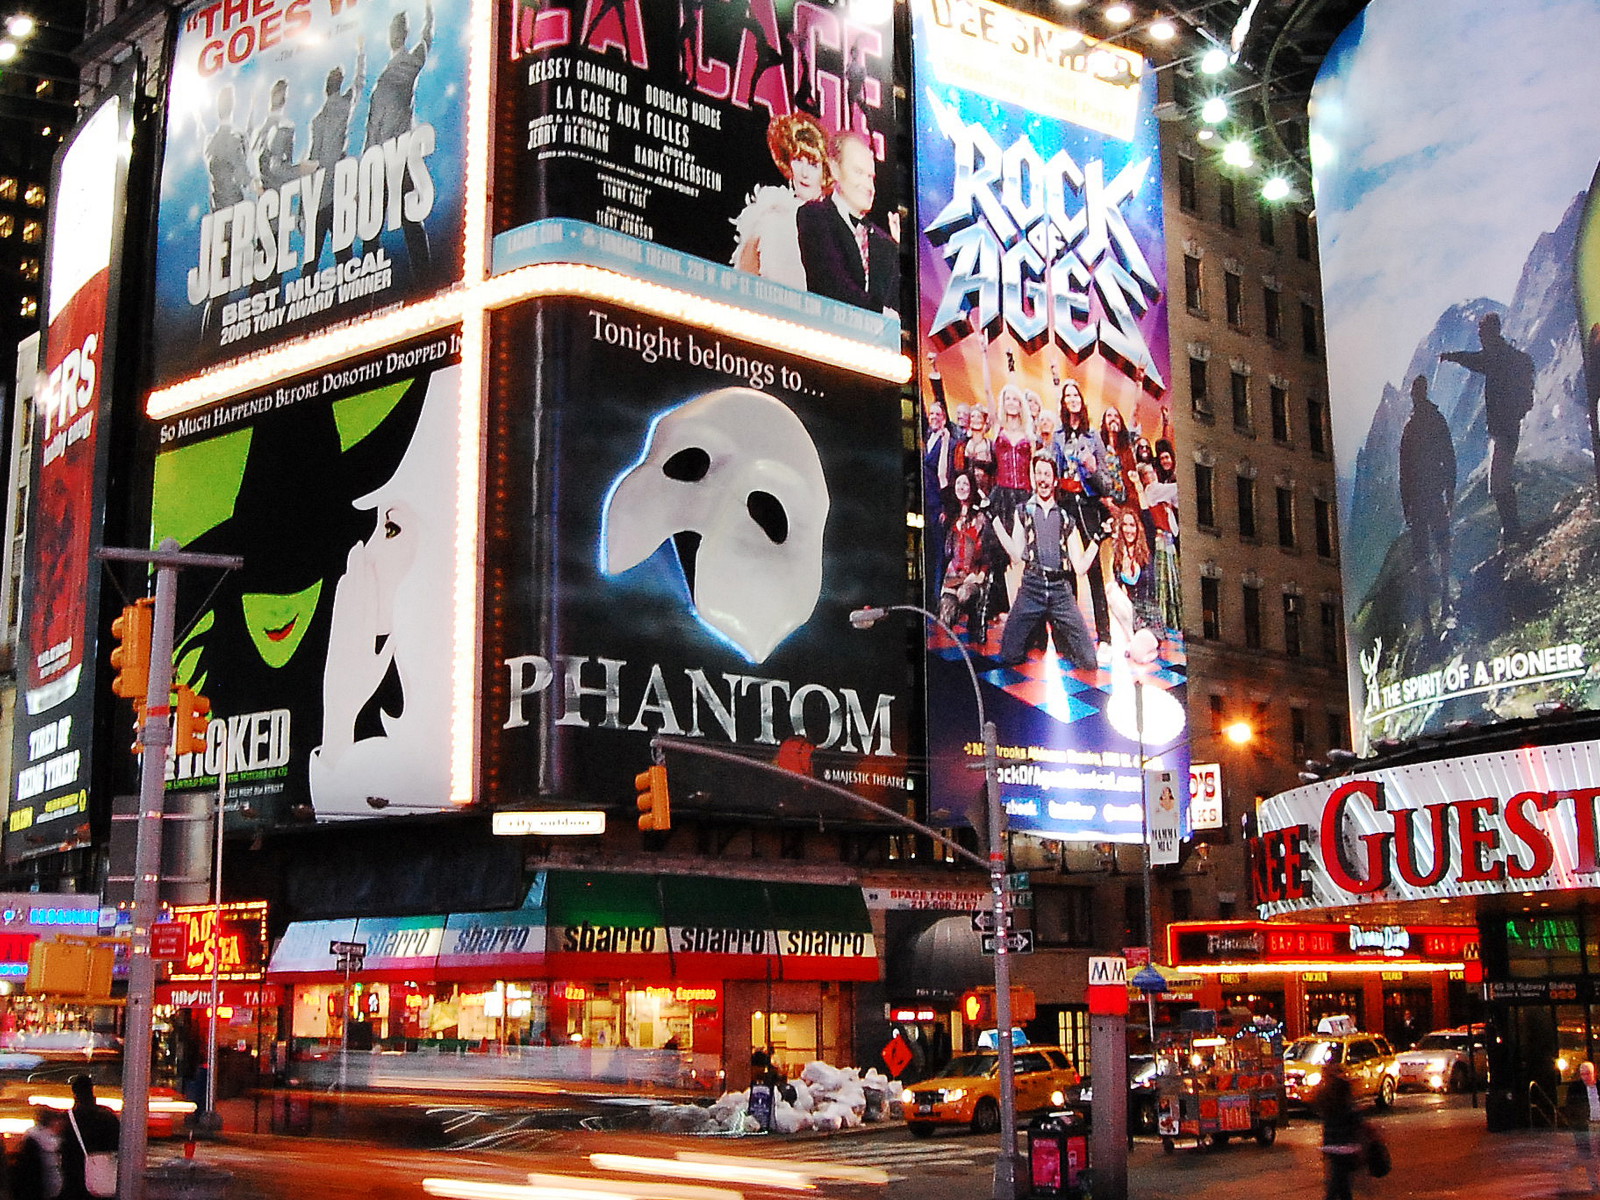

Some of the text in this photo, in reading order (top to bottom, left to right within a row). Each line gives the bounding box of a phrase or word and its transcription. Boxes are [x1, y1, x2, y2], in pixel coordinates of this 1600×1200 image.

[198, 0, 312, 78] GOES
[528, 58, 628, 95] KELSEY GRAMMER
[556, 85, 690, 148] LA CAGE AUX FOLLES
[646, 84, 722, 131] DOUGLAS HODGE
[563, 125, 609, 153] HERMAN
[634, 144, 672, 174] HARVEY
[187, 123, 436, 306] JERSEY BOYS
[923, 86, 1160, 304] ROCK
[222, 249, 391, 327] BEST MUSICAL
[254, 305, 287, 333] TONY
[286, 289, 336, 323] AWARD
[338, 268, 392, 304] WINNER
[927, 217, 1166, 392] AGES
[588, 309, 682, 364] Tonight
[688, 334, 775, 390] belongs
[160, 426, 177, 443] SO
[178, 414, 211, 442] MUCH
[213, 399, 273, 432] HAPPENED
[275, 382, 319, 409] BEFORE
[322, 361, 384, 397] DOROTHY
[386, 341, 447, 374] DROPPED
[1382, 643, 1584, 709] THE SPIRIT OF A PIONEER
[503, 654, 897, 757] PHANTOM
[832, 769, 870, 785] MAJESTIC
[872, 772, 905, 789] THEATRE
[890, 889, 985, 902] SPACE FOR RENT
[367, 929, 430, 956] sbarro
[454, 922, 530, 952] sbarro
[563, 920, 656, 953] sbarro
[680, 927, 765, 954] sbarro
[787, 929, 865, 956] sbarro
